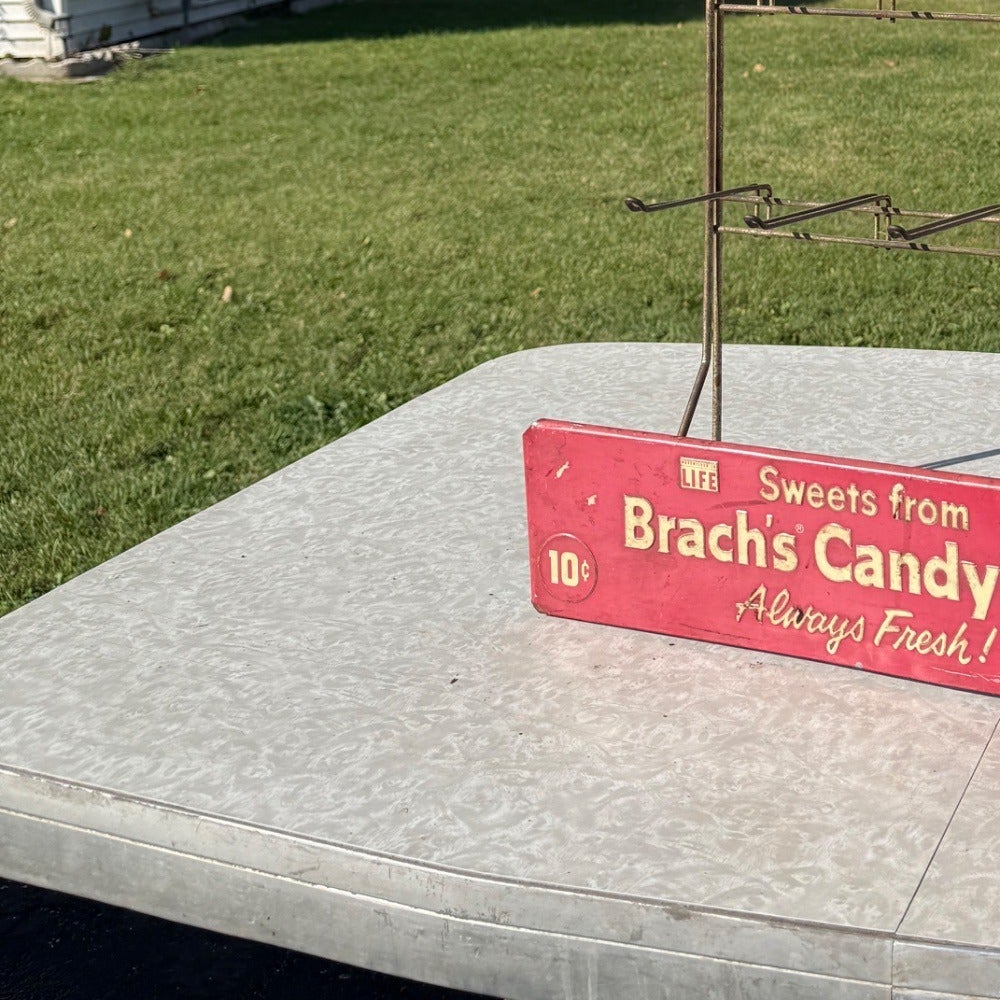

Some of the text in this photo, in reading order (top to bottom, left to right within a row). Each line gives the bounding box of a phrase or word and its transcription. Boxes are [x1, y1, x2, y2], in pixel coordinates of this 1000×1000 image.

[682, 468, 717, 491] LIFE
[758, 465, 970, 531] Sweets from
[735, 583, 999, 666] Always Fresh!
